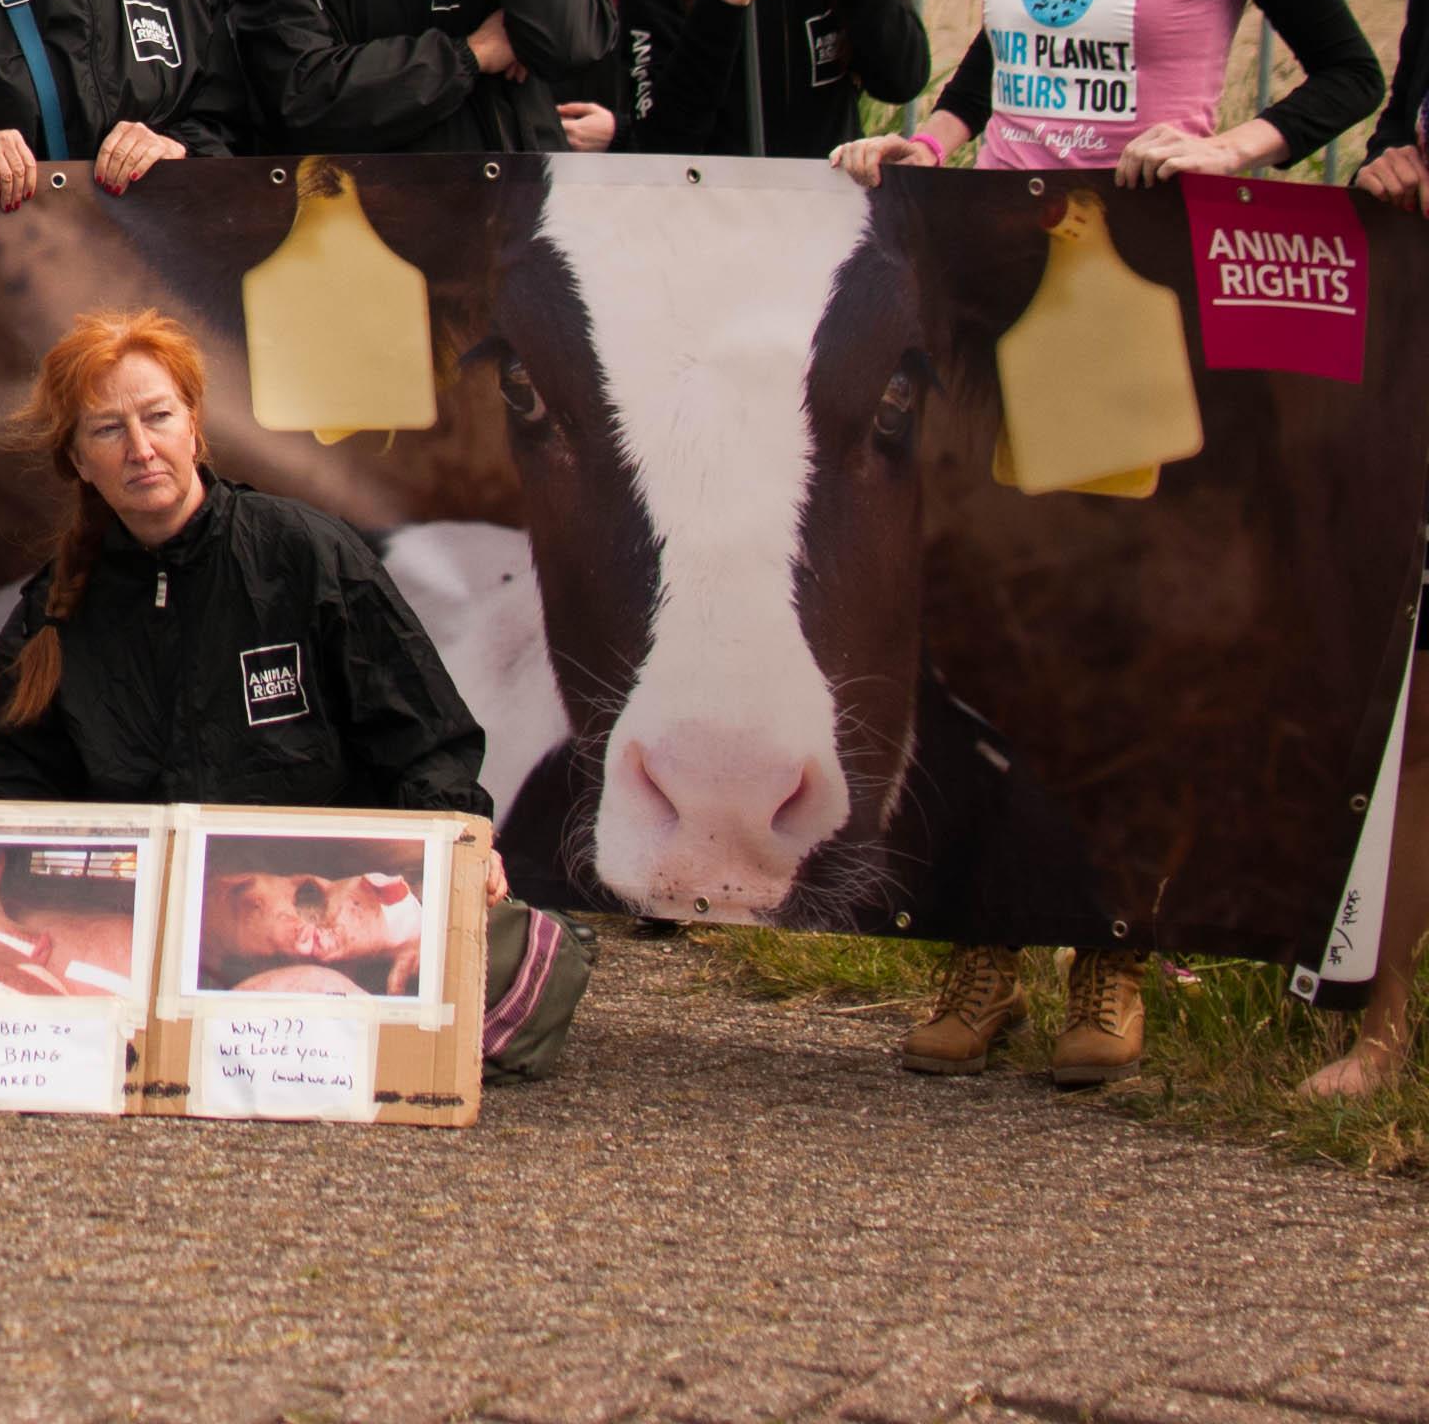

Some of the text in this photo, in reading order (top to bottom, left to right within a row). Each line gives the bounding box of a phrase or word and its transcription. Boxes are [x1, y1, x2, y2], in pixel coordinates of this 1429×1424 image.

[1035, 34, 1136, 71] PLANET.
[1075, 78, 1137, 113] TOO.
[1208, 229, 1356, 268] ANIMAL
[1219, 264, 1350, 303] RIGHTS
[0, 1022, 37, 1036] BEN
[4, 1048, 63, 1063] BANG
